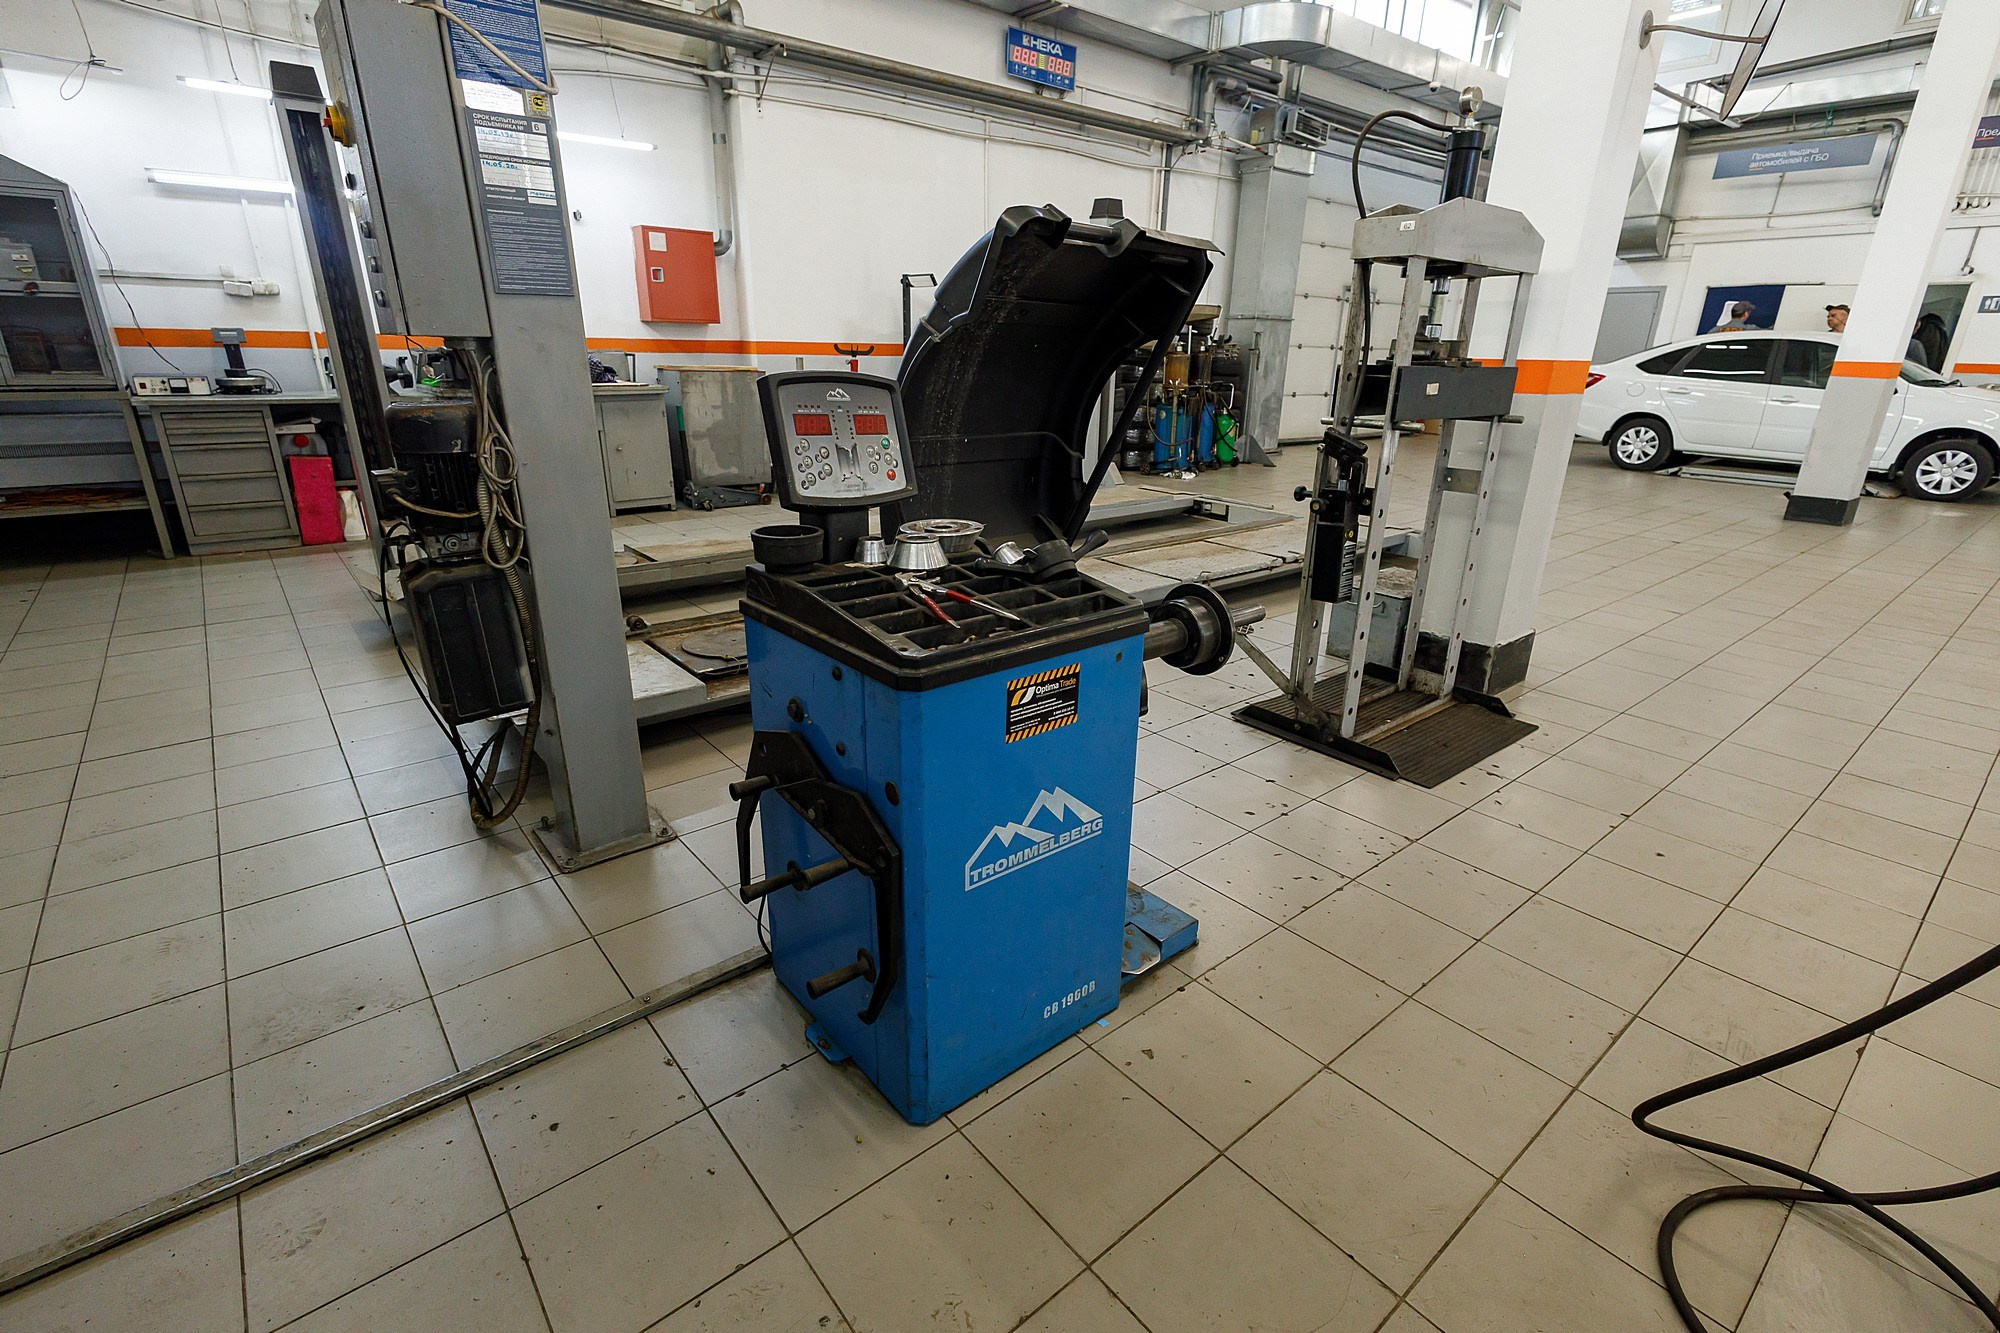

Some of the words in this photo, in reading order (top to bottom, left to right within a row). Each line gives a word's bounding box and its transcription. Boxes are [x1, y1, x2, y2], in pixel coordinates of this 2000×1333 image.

[473, 113, 490, 121] СРОК
[490, 114, 528, 126] ИСПЫТАНИЯ
[1750, 156, 1803, 168] автомобилей
[1810, 153, 1829, 162] ГБО
[1036, 682, 1060, 695] Optima
[1060, 677, 1077, 688] Trade
[970, 818, 1103, 883] TROMMELBERG
[1043, 1001, 1059, 1019] CB
